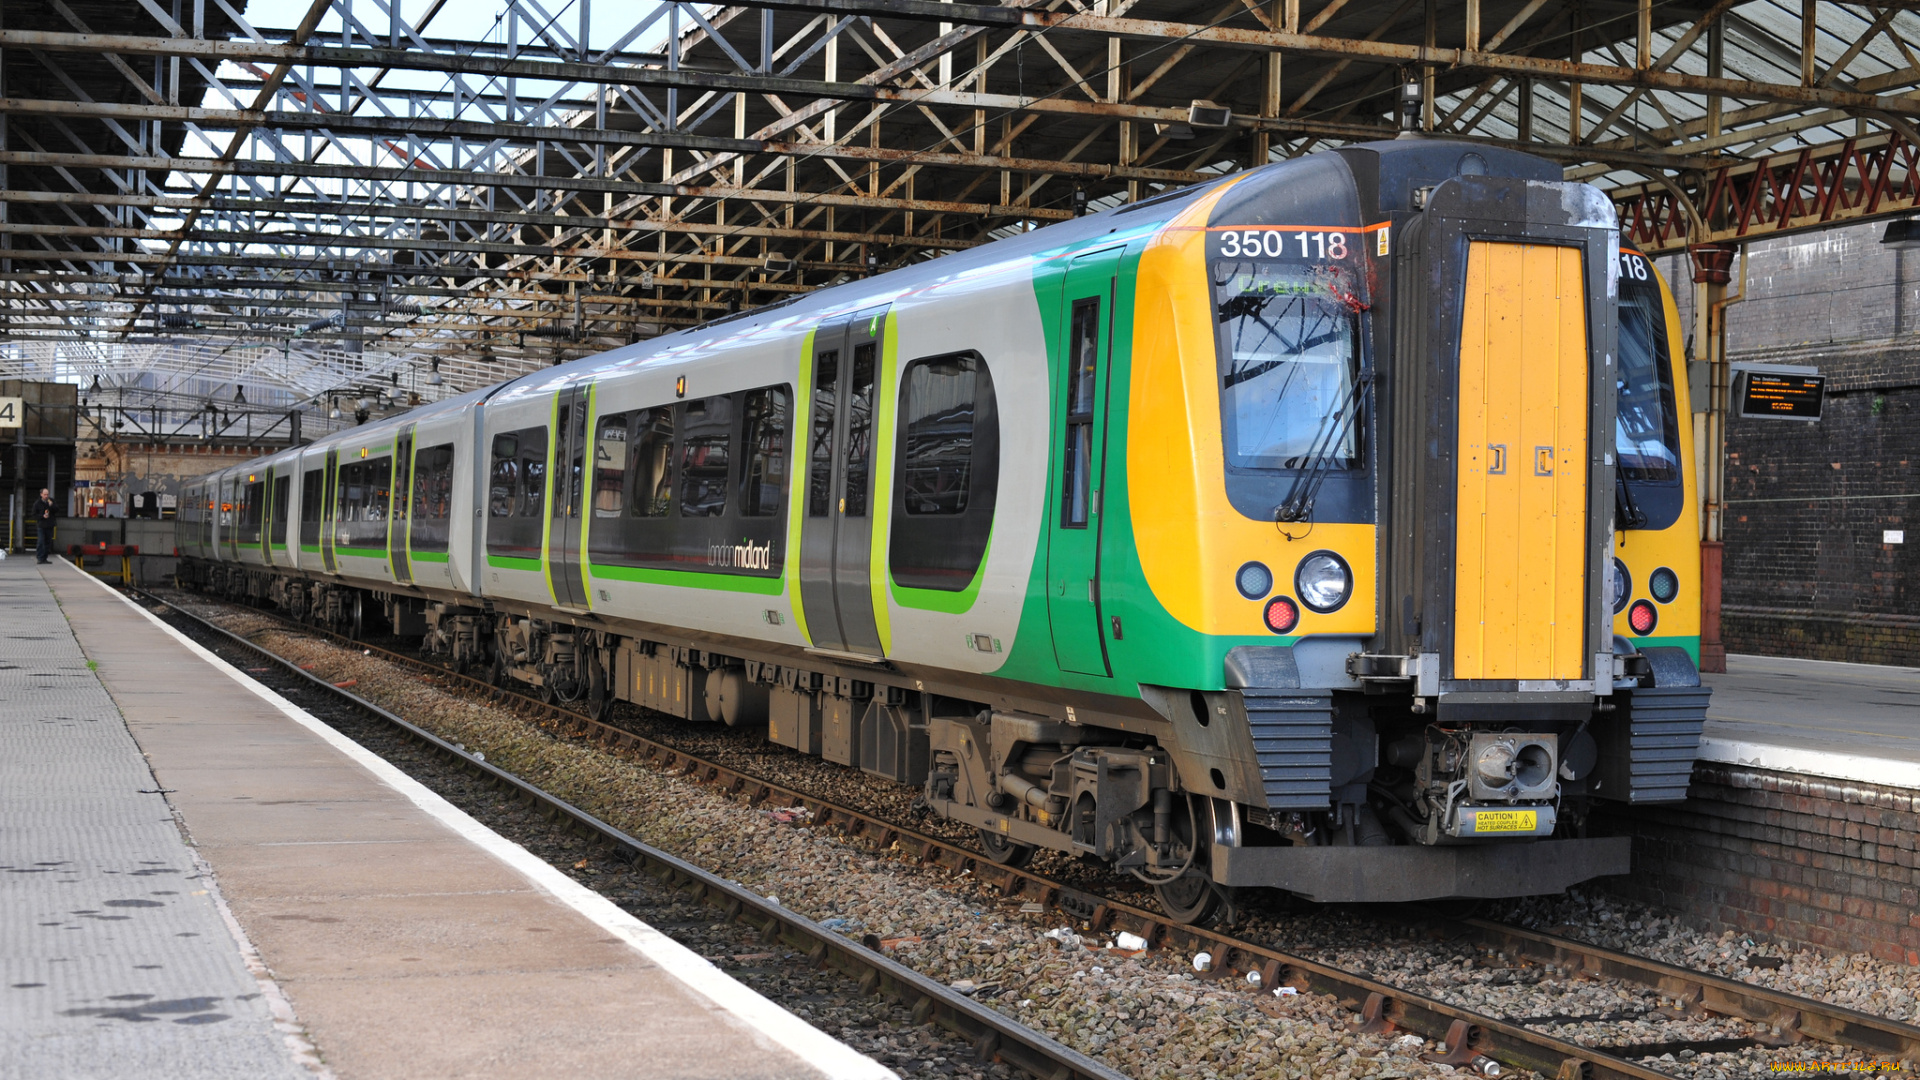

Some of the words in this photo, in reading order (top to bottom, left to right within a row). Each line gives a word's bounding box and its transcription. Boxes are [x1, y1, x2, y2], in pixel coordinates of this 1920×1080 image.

[1220, 230, 1283, 258] 350
[1294, 231, 1348, 260] 118
[0, 402, 15, 422] 4
[1478, 812, 1513, 820] CAUTION
